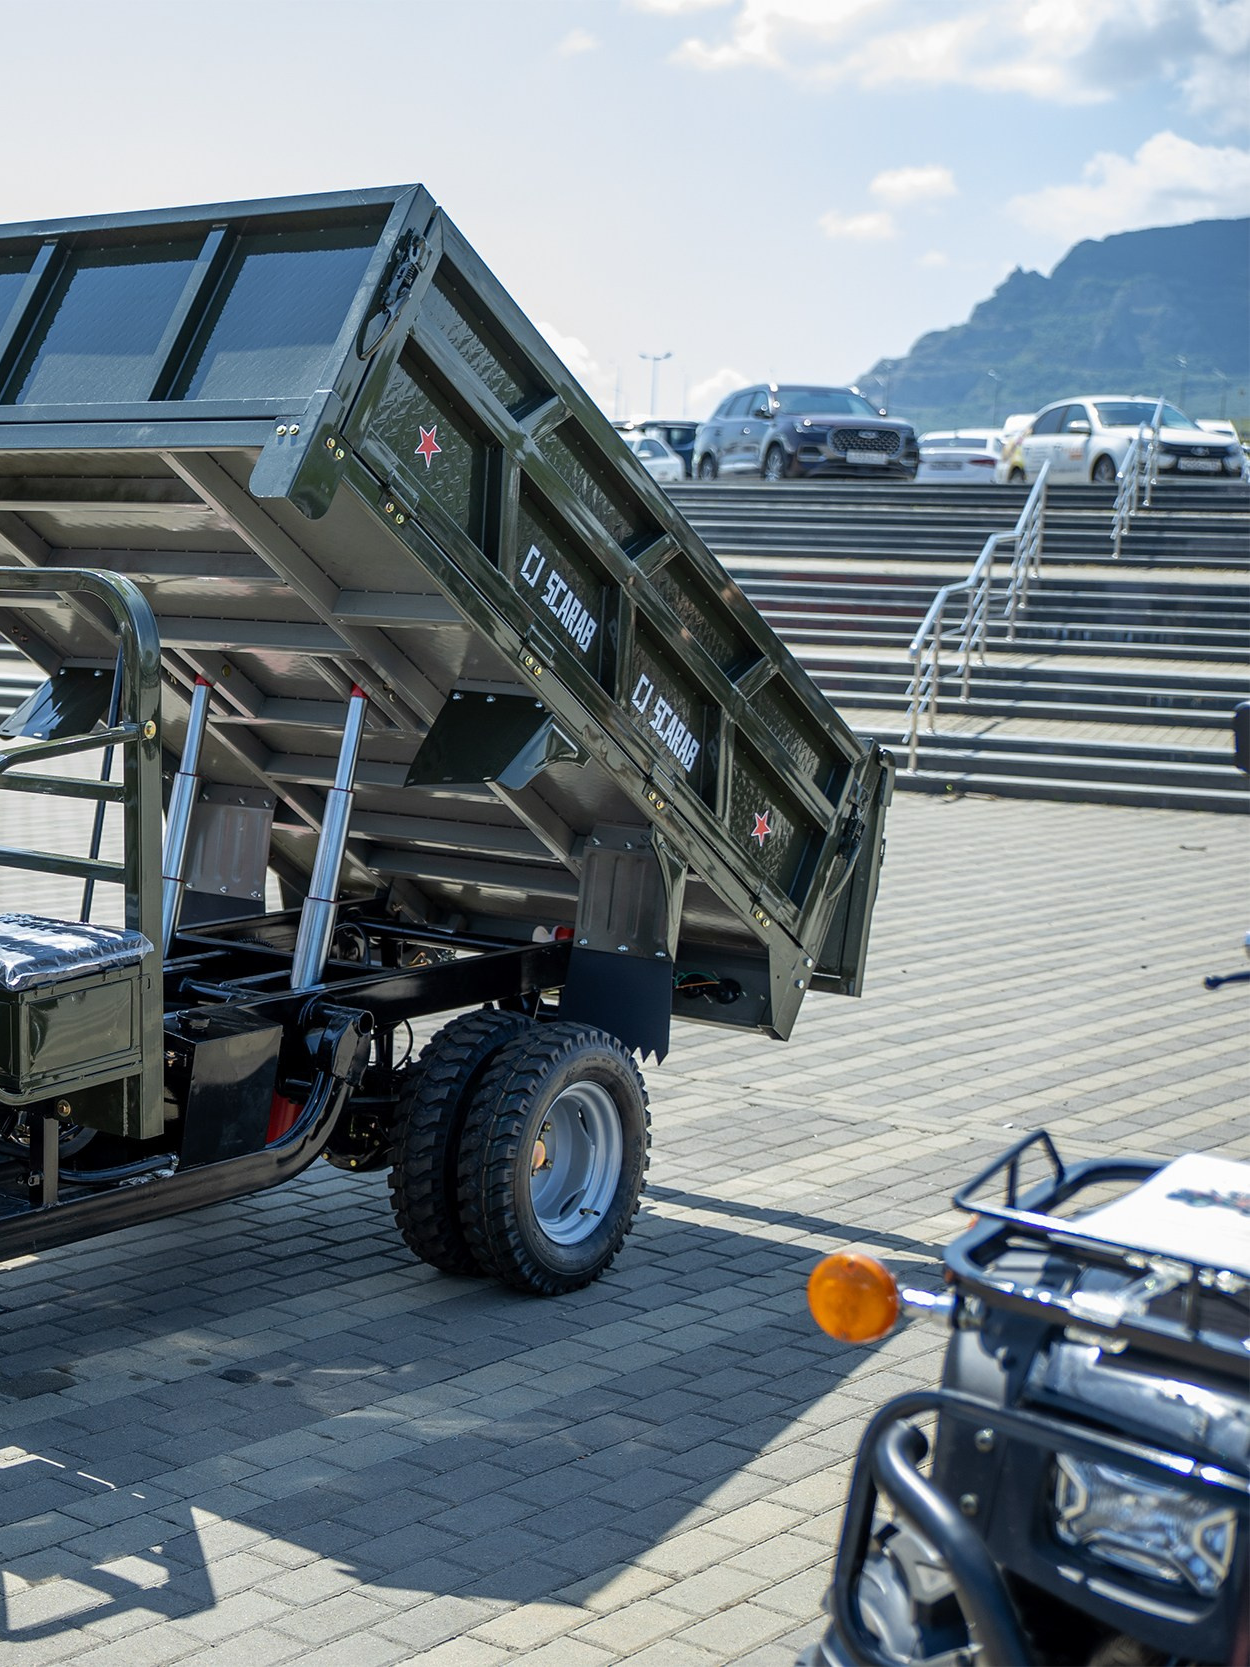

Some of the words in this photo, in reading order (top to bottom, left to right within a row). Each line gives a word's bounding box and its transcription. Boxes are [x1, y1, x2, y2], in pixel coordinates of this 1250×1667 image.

[520, 544, 546, 588] CJ
[541, 569, 597, 653] SCARAB
[632, 673, 654, 714] CJ
[649, 696, 700, 773] SCARAB
